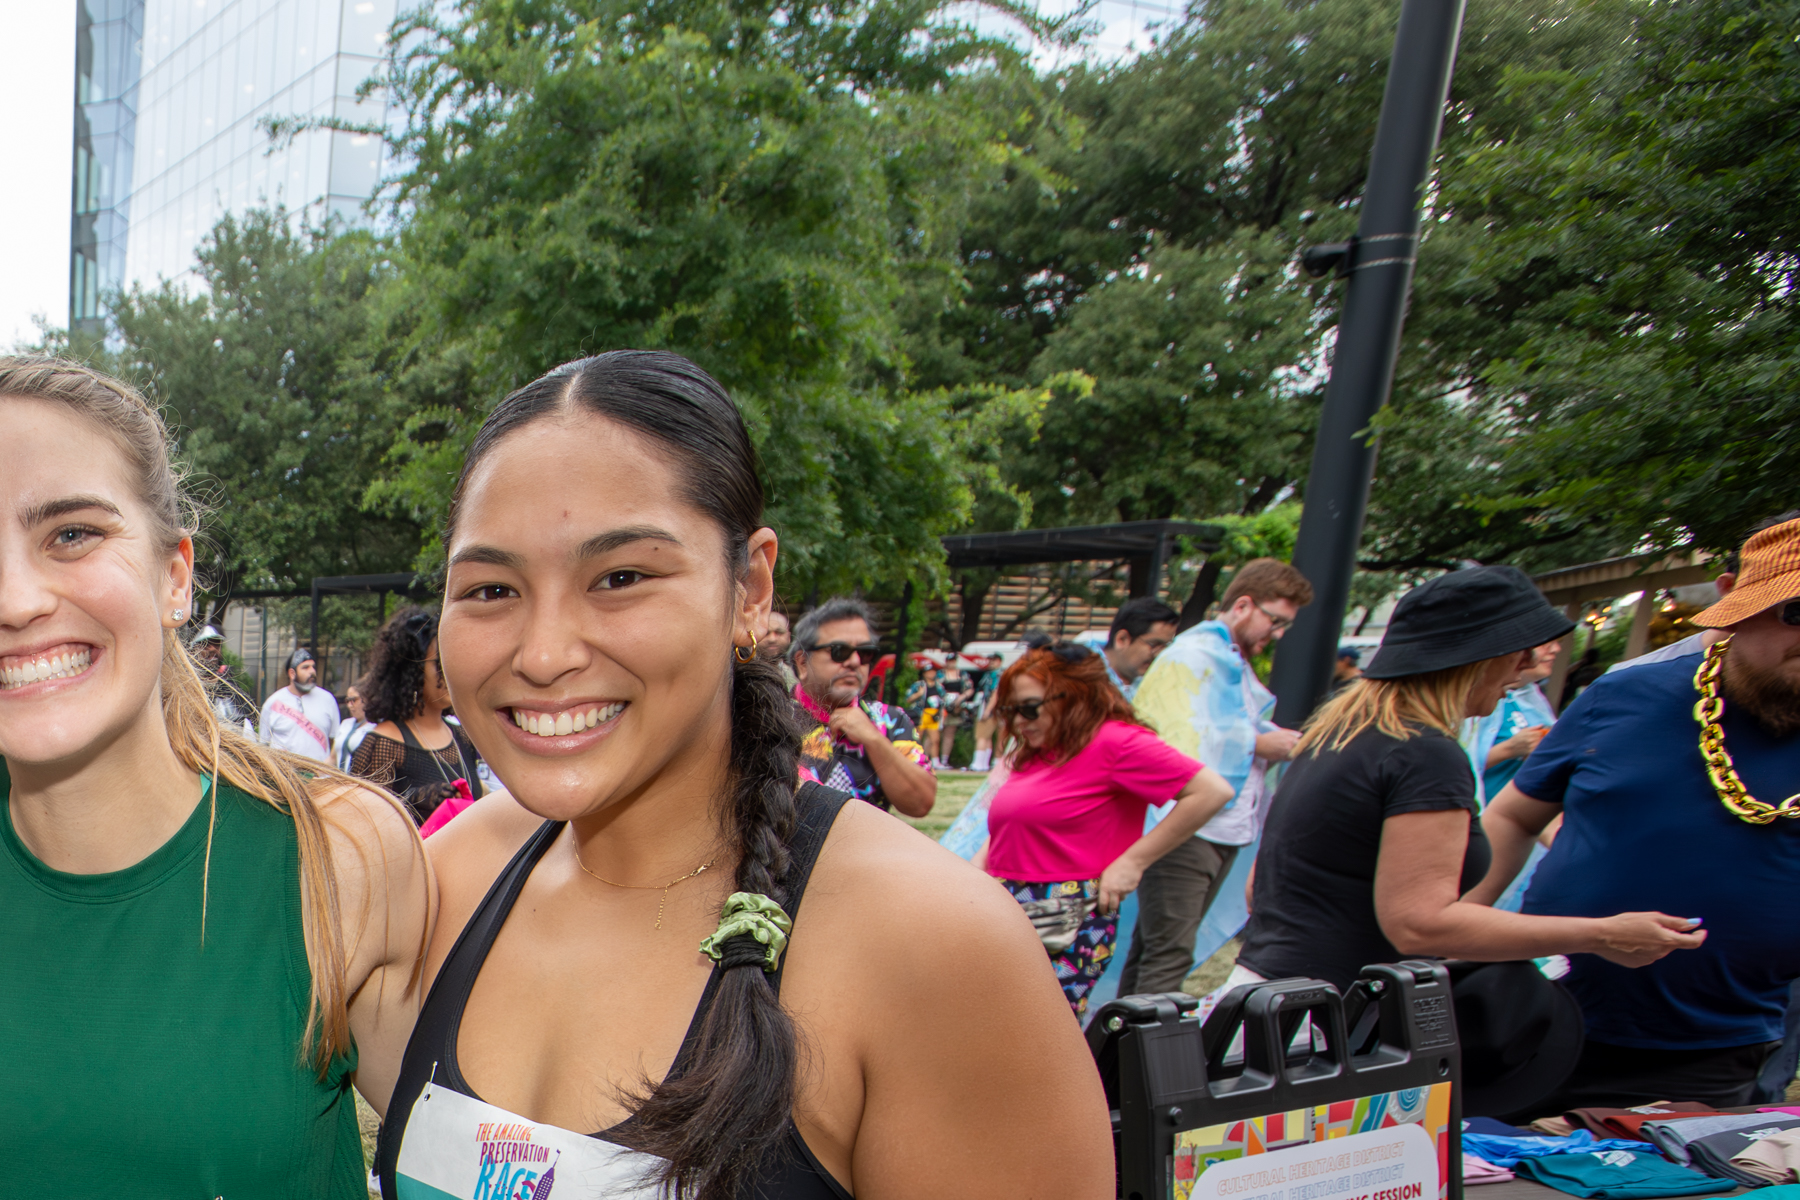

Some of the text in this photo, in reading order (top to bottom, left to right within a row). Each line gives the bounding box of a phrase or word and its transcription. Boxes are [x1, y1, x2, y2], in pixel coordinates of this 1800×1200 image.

[475, 1123, 535, 1142] THE AMAZING
[479, 1142, 550, 1167] PRESERVATION
[1216, 1141, 1404, 1196] CULTURAL HERITAGE DISTRICT
[1352, 1163, 1404, 1189] DISTRICT
